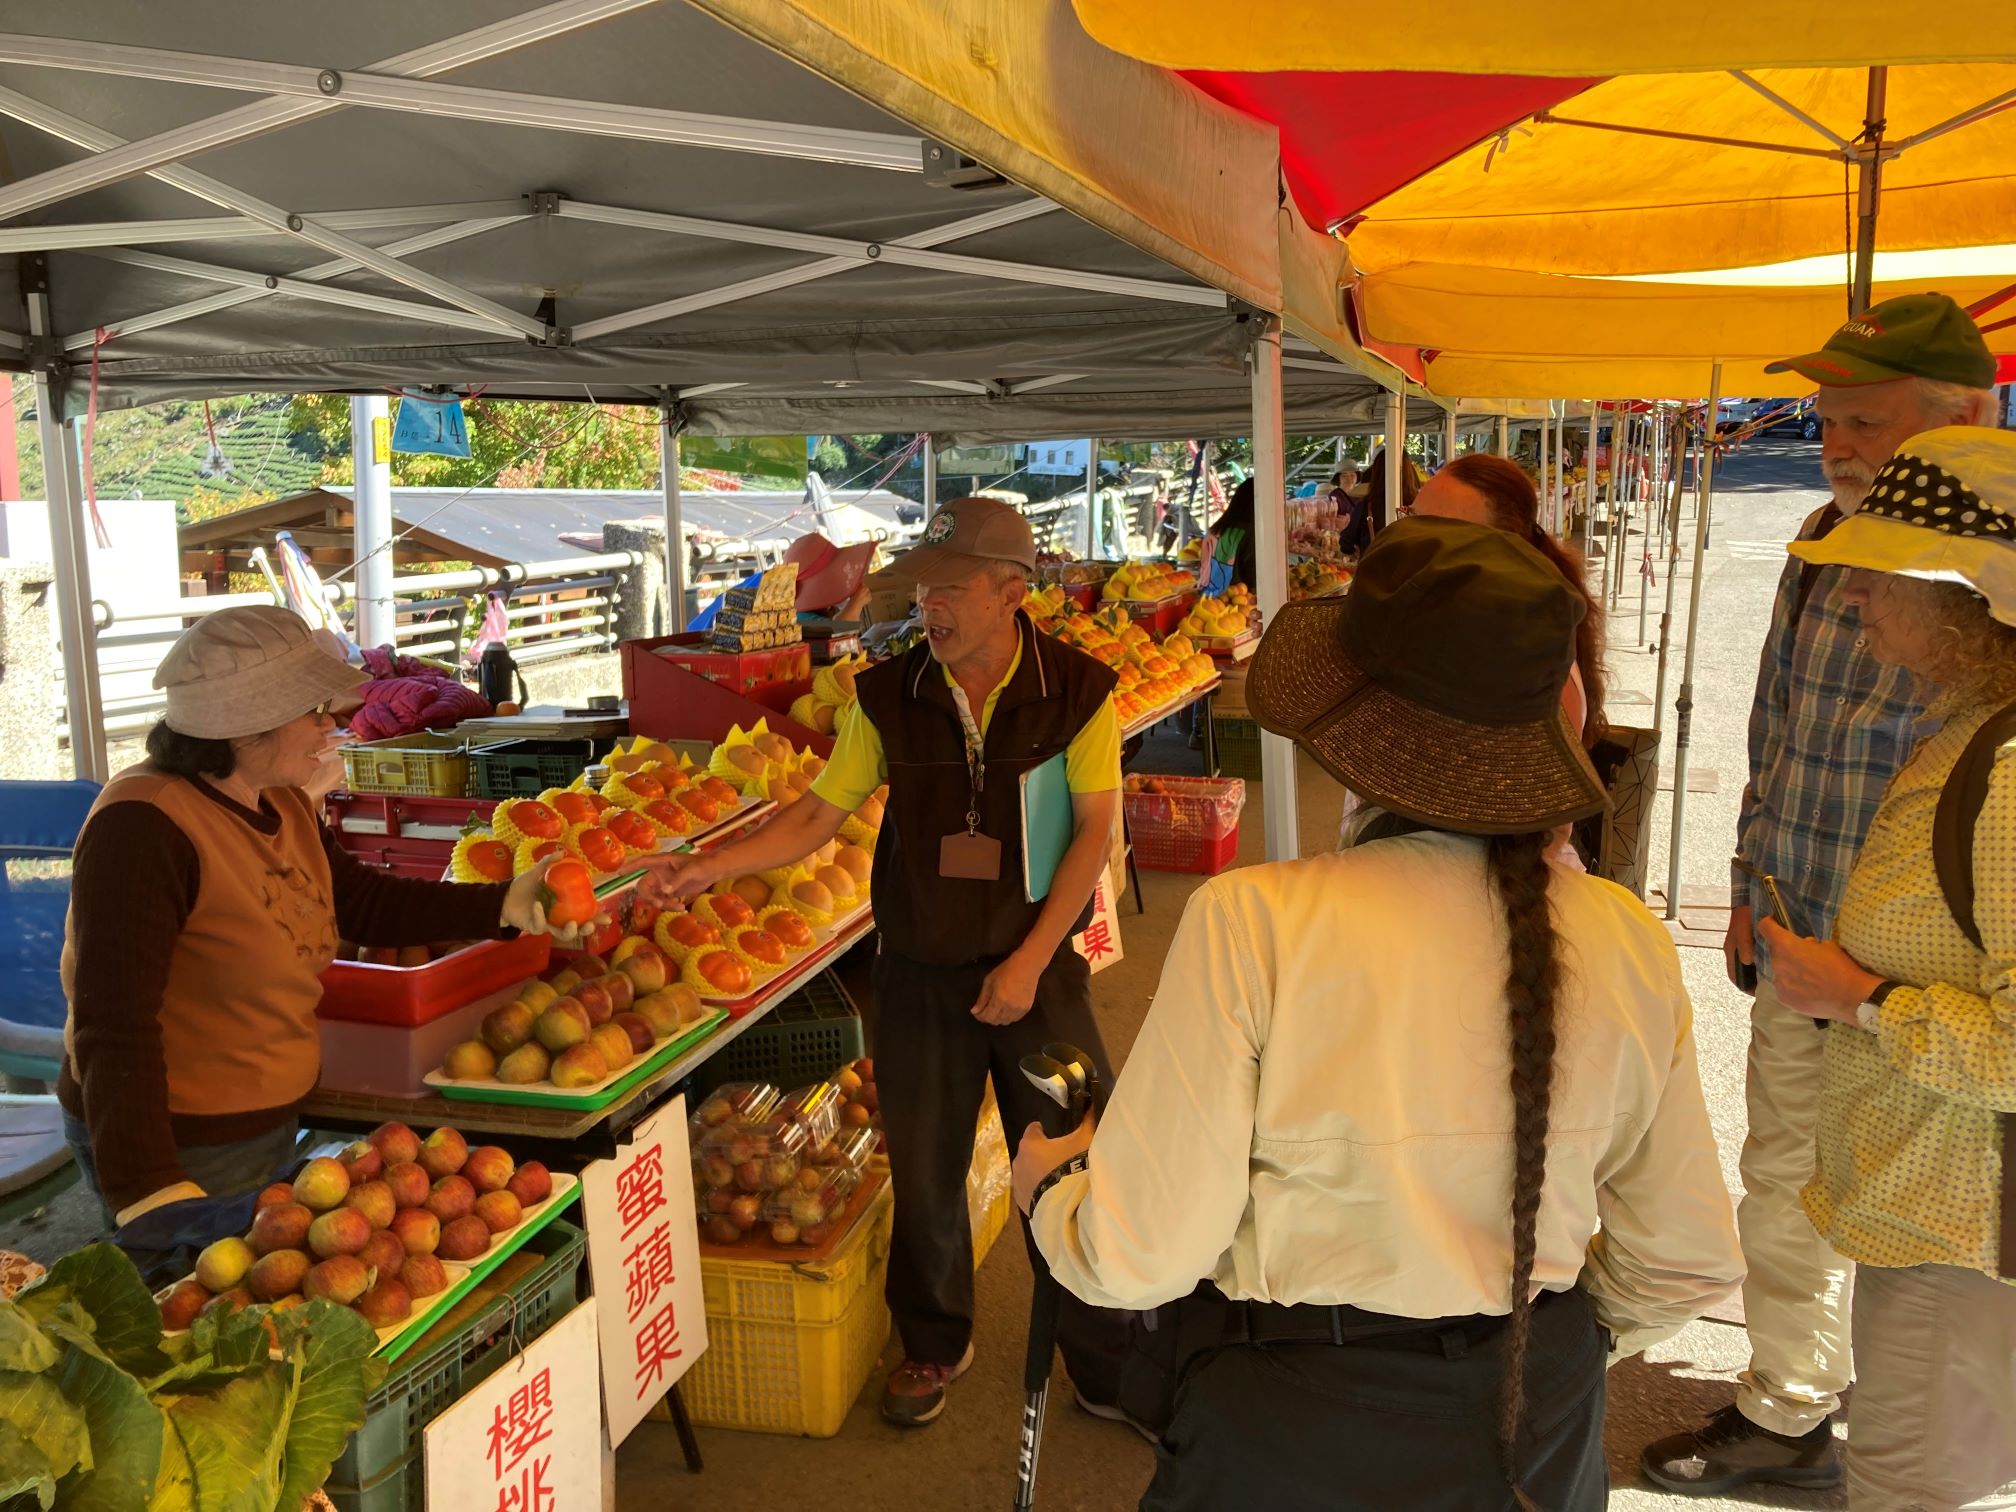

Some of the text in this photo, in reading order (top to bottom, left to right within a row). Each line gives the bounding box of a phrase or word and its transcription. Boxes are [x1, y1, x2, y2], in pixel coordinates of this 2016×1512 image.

[616, 1143, 682, 1400] 蜜蘋果
[1018, 1404, 1037, 1482] LEKI
